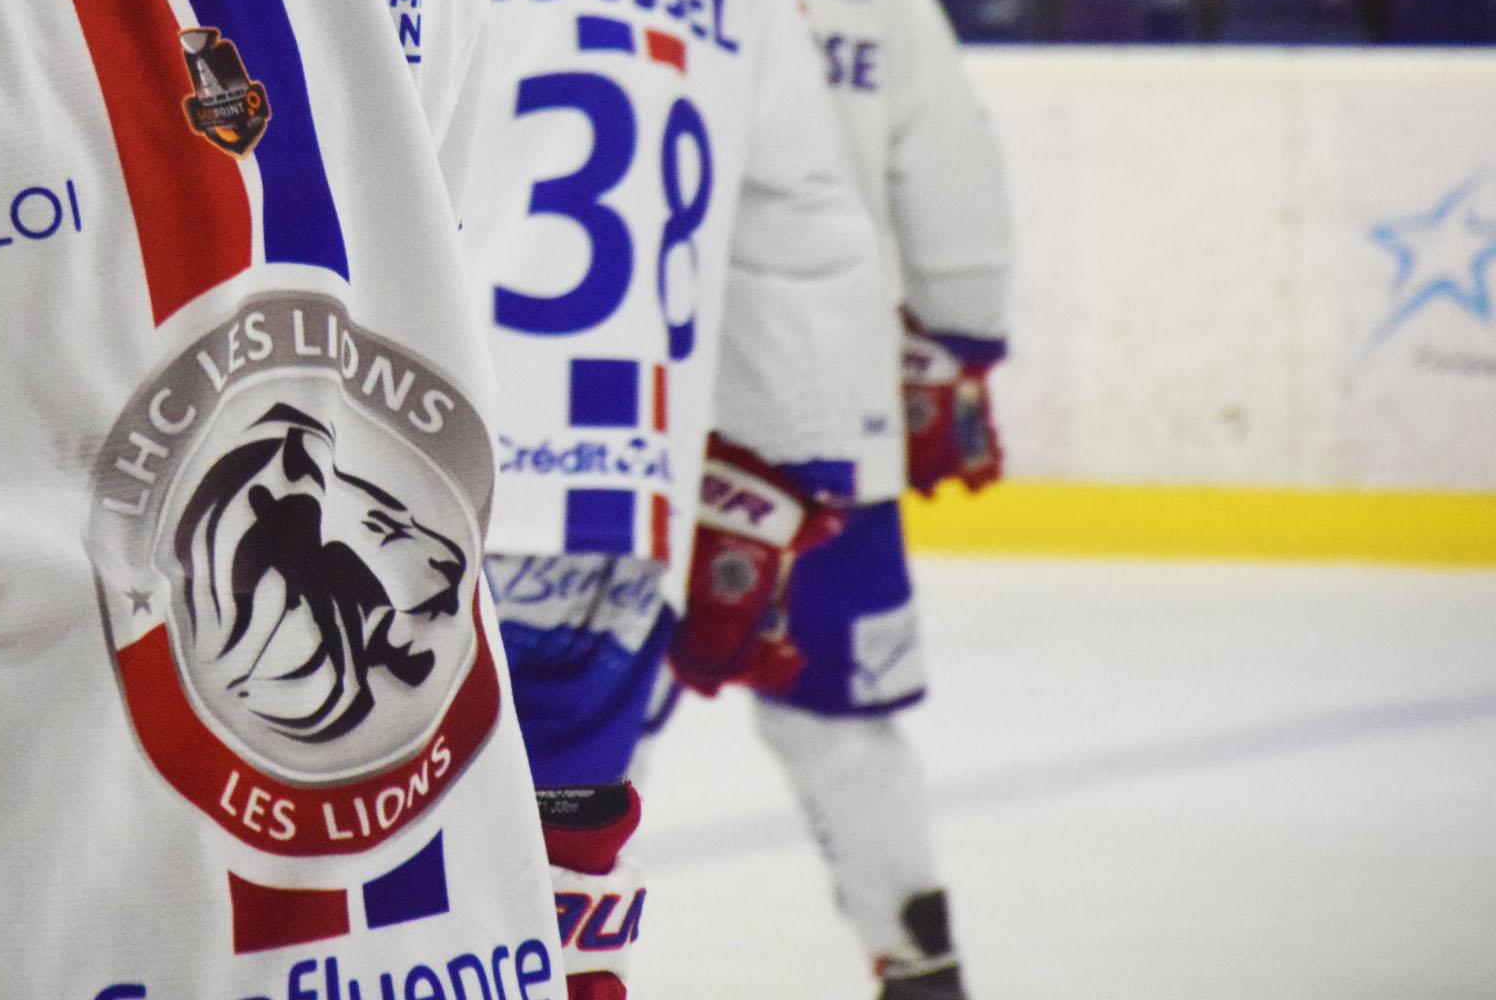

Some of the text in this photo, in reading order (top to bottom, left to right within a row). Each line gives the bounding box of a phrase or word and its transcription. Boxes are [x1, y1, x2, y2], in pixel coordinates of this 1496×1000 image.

[493, 72, 714, 362] 38
[101, 309, 455, 517] LHC LES LIONS
[219, 735, 453, 843] LES LIONS
